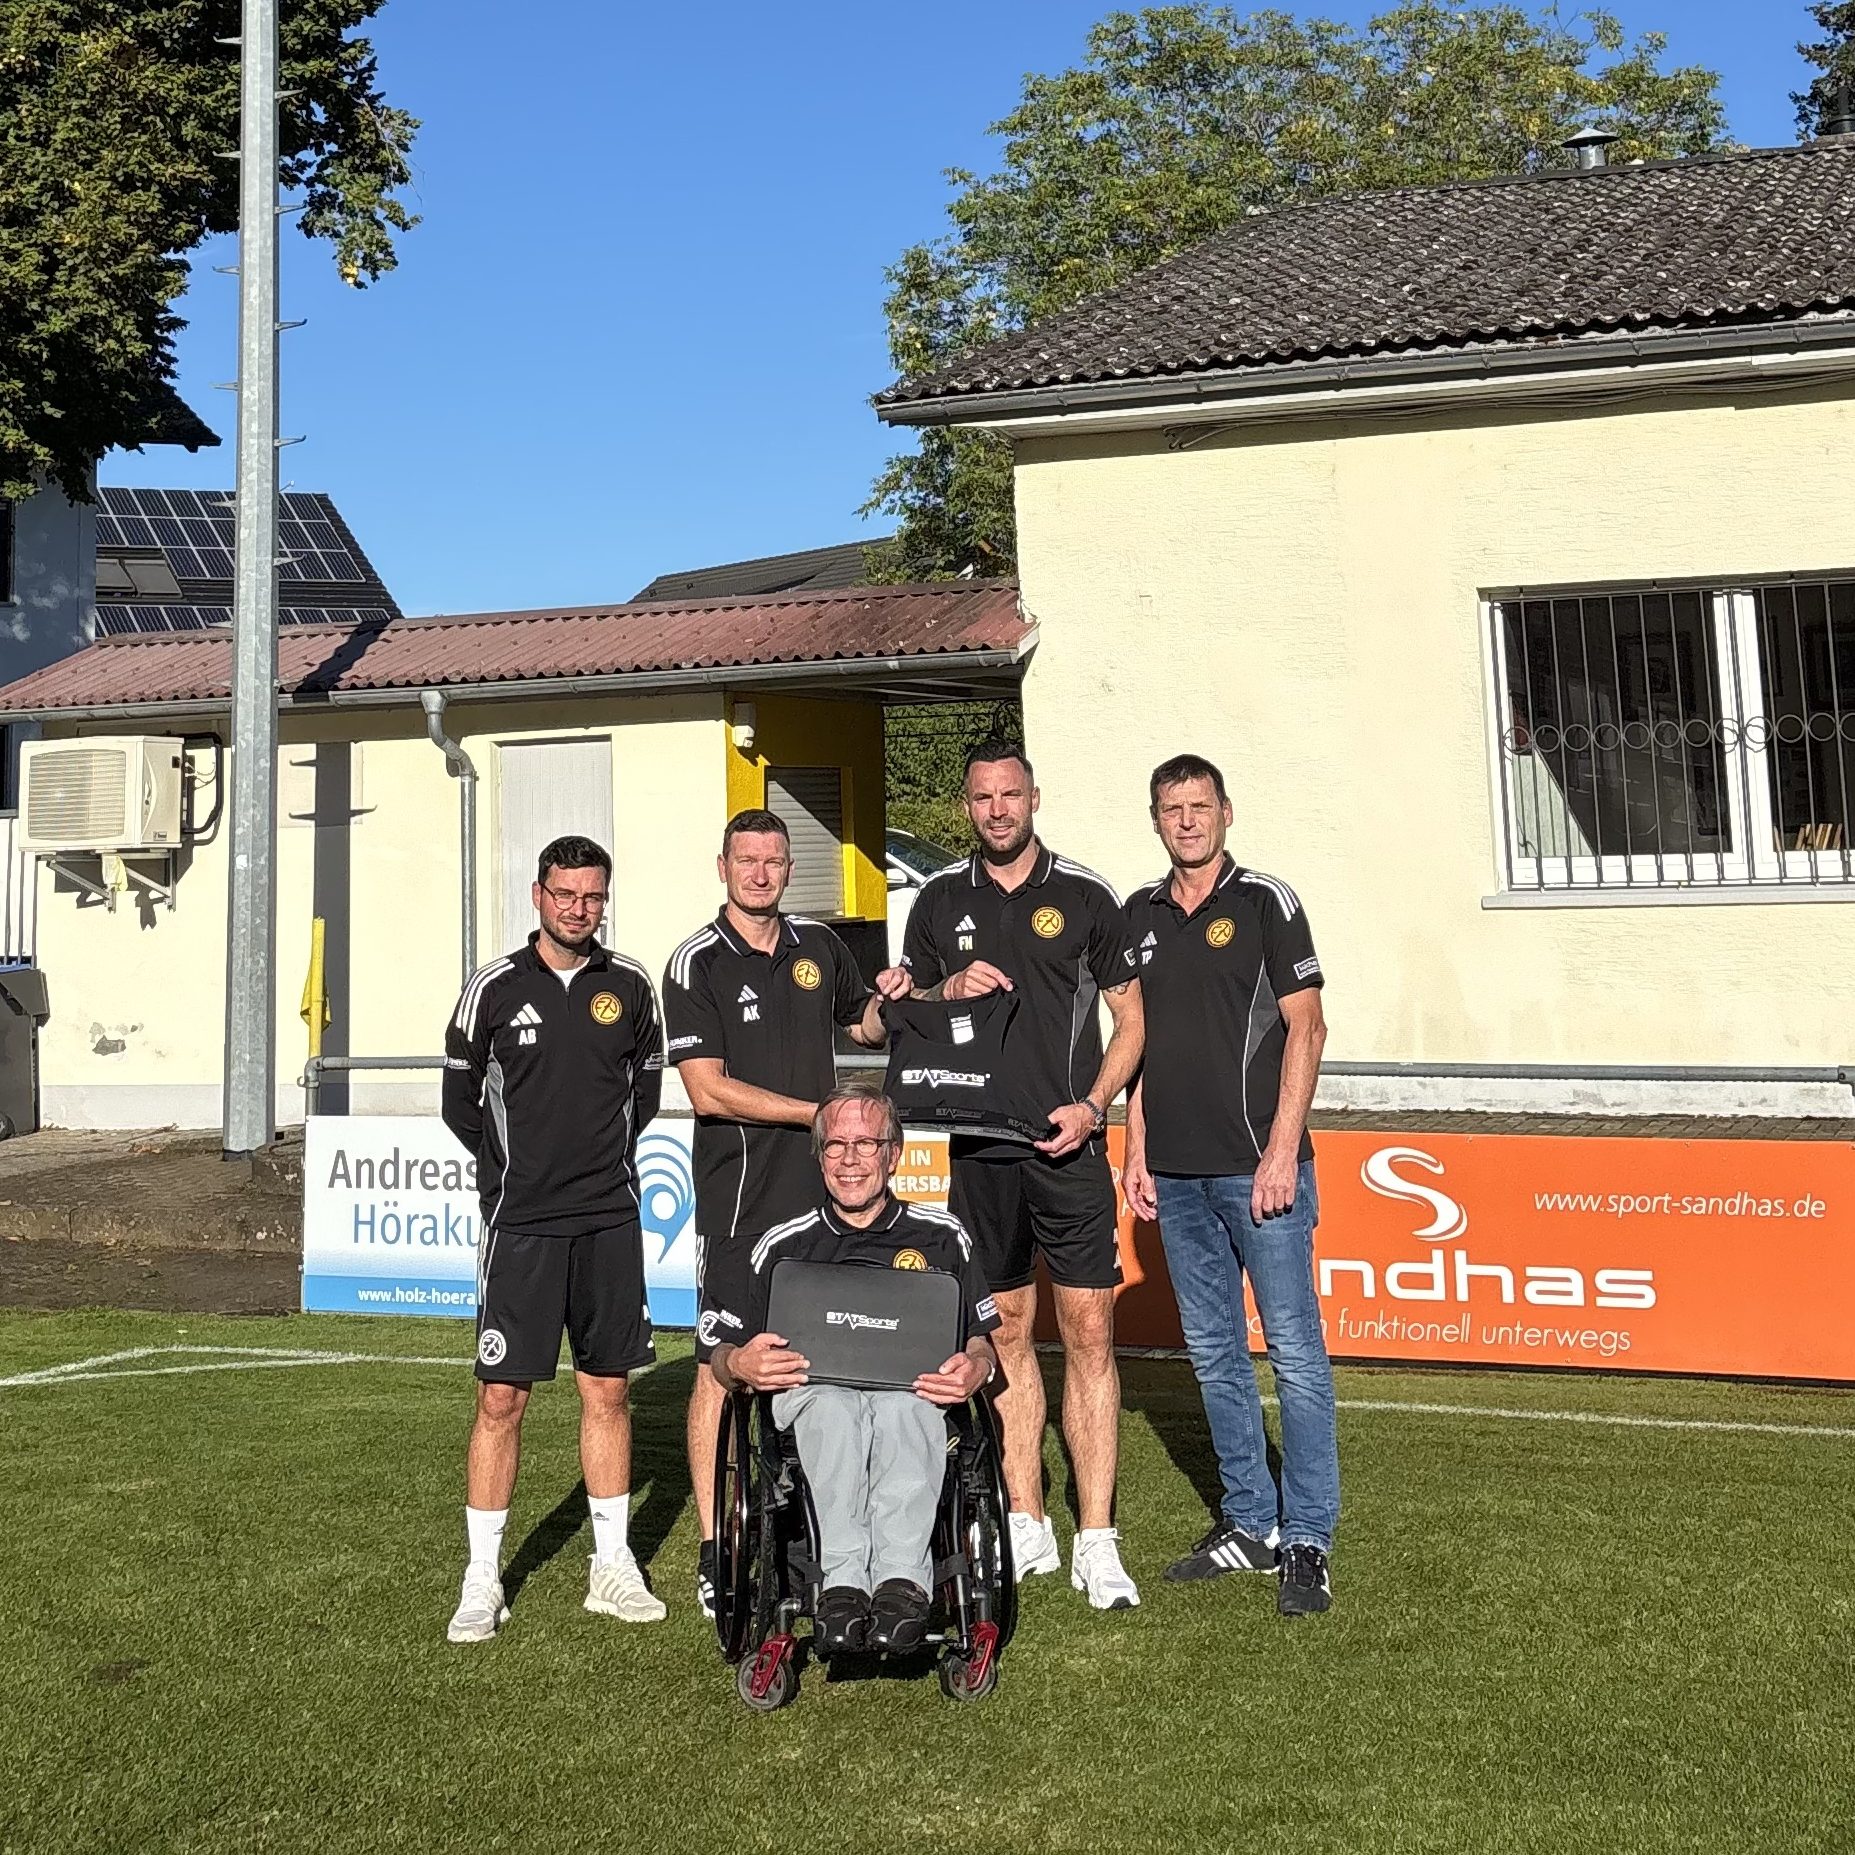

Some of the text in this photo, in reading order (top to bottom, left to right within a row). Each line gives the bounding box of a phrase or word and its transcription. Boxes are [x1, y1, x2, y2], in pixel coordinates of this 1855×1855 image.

[958, 935, 973, 951] FH
[1142, 950, 1153, 965] TP
[743, 1004, 761, 1022] AK
[518, 1028, 537, 1046] AB
[910, 1149, 932, 1166] IN
[328, 1147, 478, 1191] Andreas
[896, 1175, 950, 1193] ERSBA
[1534, 1191, 1827, 1219] www.sport-sandhas.de
[354, 1201, 479, 1247] Höraku
[1318, 1249, 1657, 1309] ndhas
[358, 1287, 476, 1306] www.holz-hoera
[1338, 1307, 1472, 1344] funktionell
[1481, 1318, 1632, 1357] unterwegs
